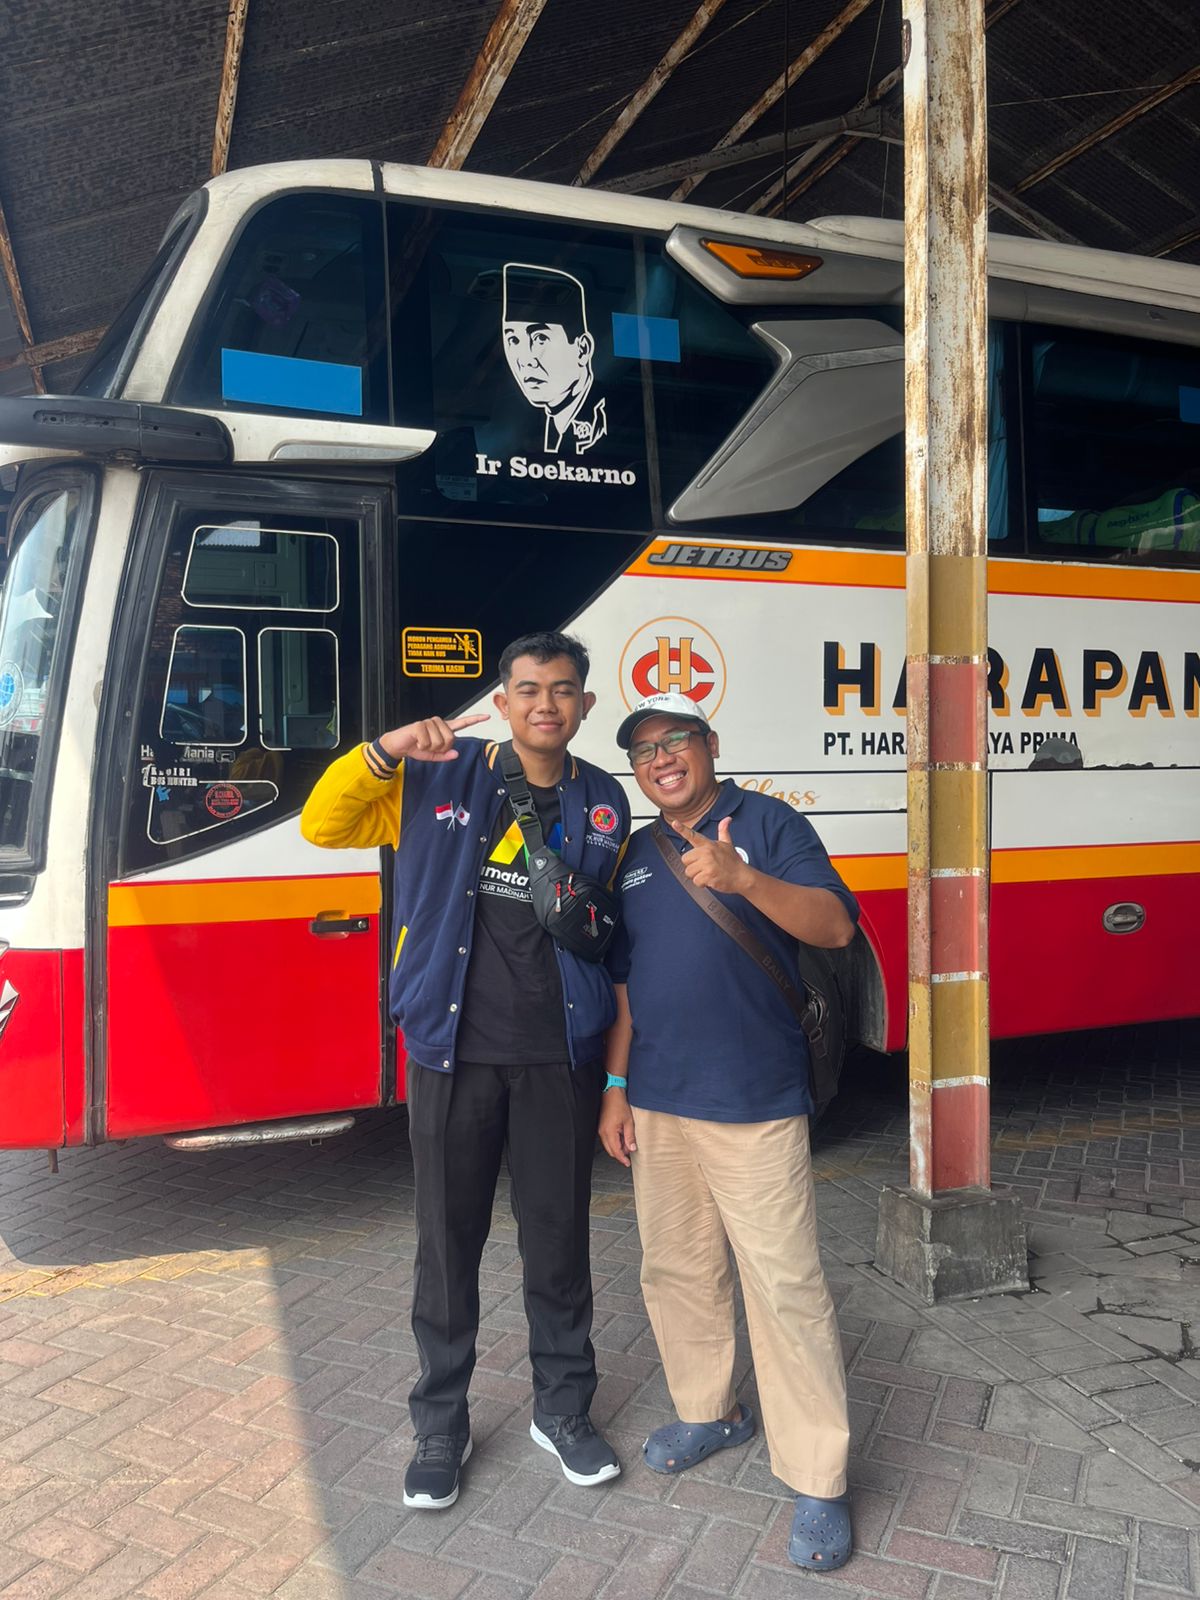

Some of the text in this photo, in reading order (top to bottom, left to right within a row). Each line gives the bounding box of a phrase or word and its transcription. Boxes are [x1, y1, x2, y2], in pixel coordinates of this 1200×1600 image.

[475, 453, 637, 486] Ir Soekarno
[648, 544, 793, 571] JETBUS
[421, 664, 465, 673] TERIMA KASIH
[823, 732, 854, 756] PT.
[479, 883, 496, 892] NUR
[761, 956, 792, 991] BALLY
